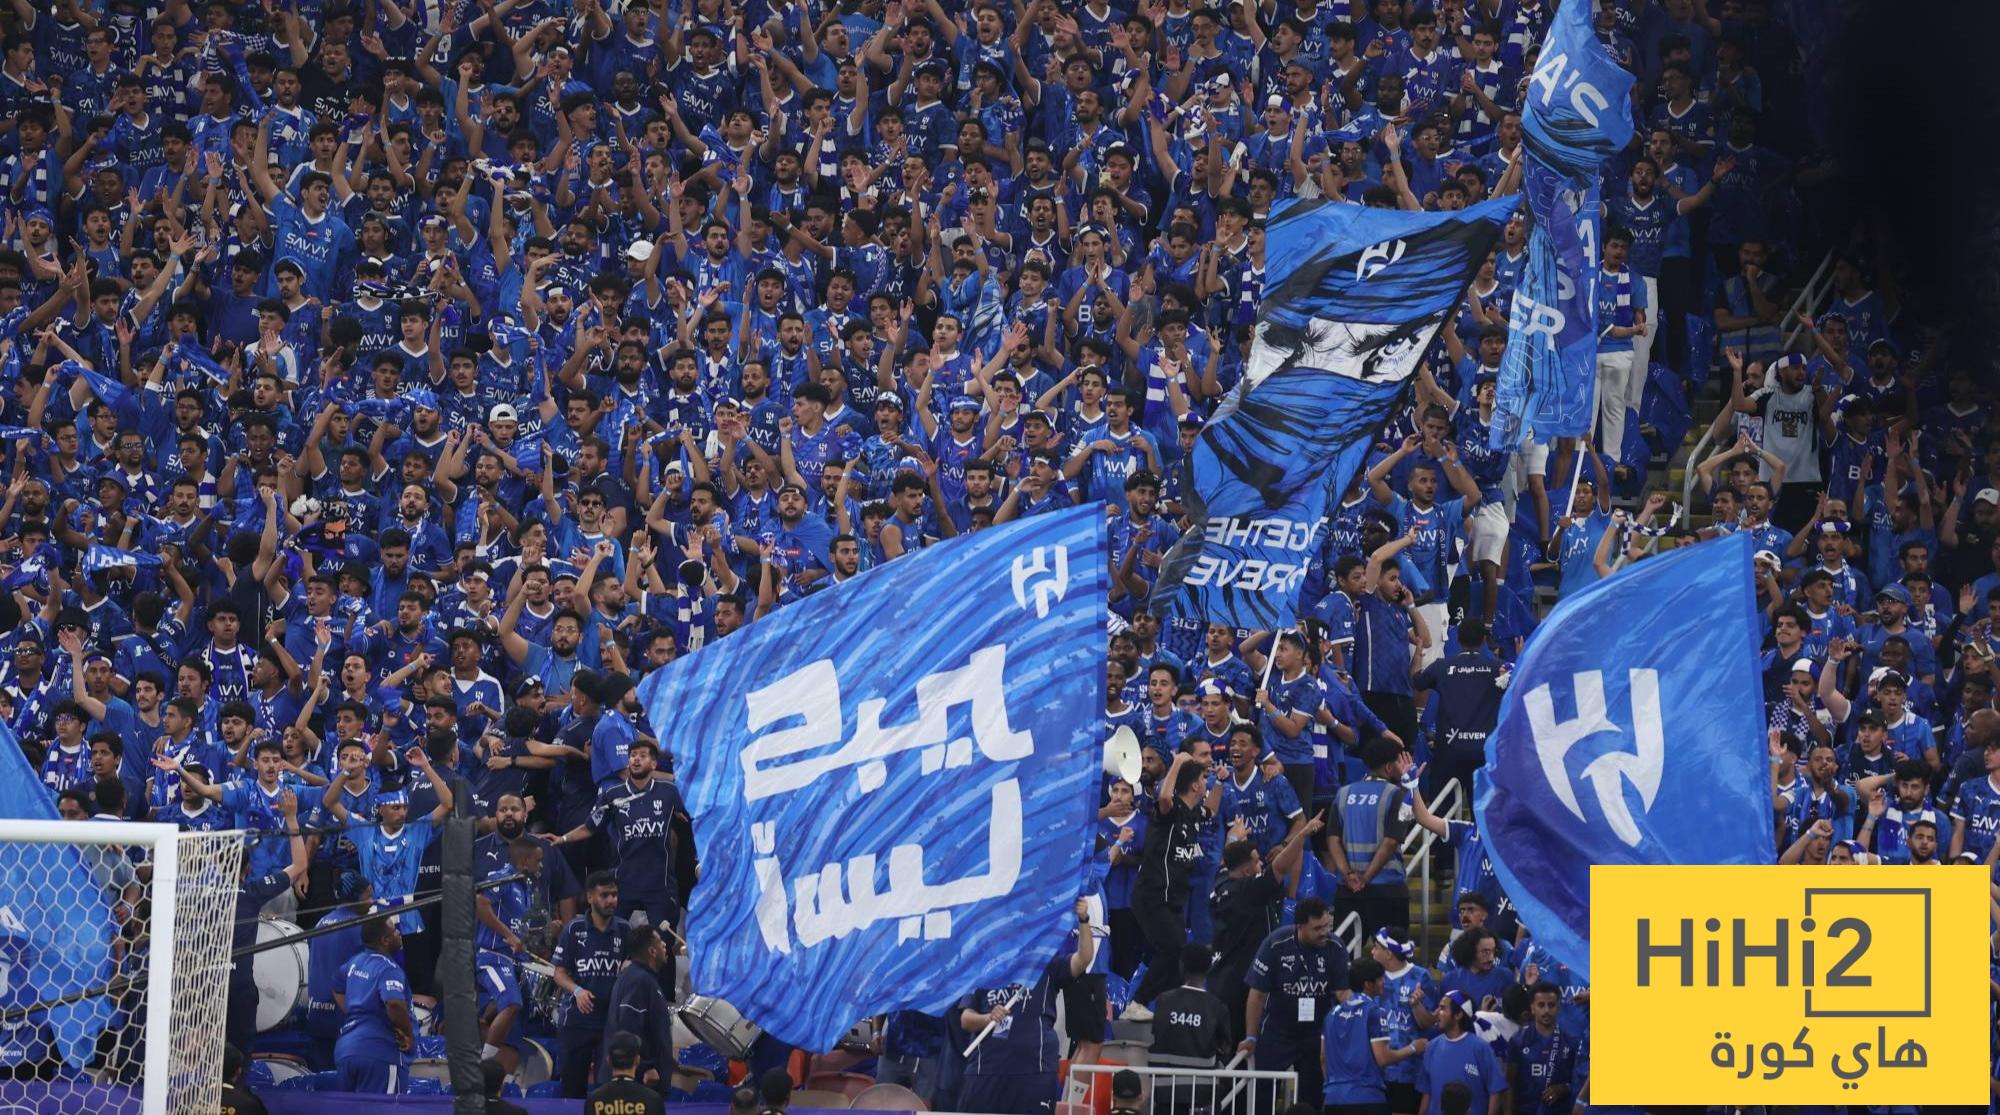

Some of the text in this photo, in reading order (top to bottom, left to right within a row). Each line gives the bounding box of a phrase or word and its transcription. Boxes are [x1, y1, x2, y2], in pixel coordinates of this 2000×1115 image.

[1616, 8, 1637, 24] SAV
[1530, 32, 1610, 128] A'S
[1414, 84, 1438, 99] AVVY
[682, 91, 714, 114] SAVVY
[286, 232, 329, 258] SAVVY
[359, 334, 395, 347] AVVY
[518, 418, 542, 436] SAV
[943, 465, 965, 480] SAV
[1458, 731, 1487, 741] SEVEN
[1347, 794, 1379, 806] 878
[624, 821, 666, 838] SAVVY
[1972, 814, 2000, 831] SAV
[419, 864, 441, 874] EVEN
[576, 958, 623, 973] SAVVY
[1283, 981, 1328, 994] SAVVY
[312, 1001, 336, 1011] SEVEN
[1170, 1011, 1202, 1027] 3448
[594, 1100, 646, 1115] Police
